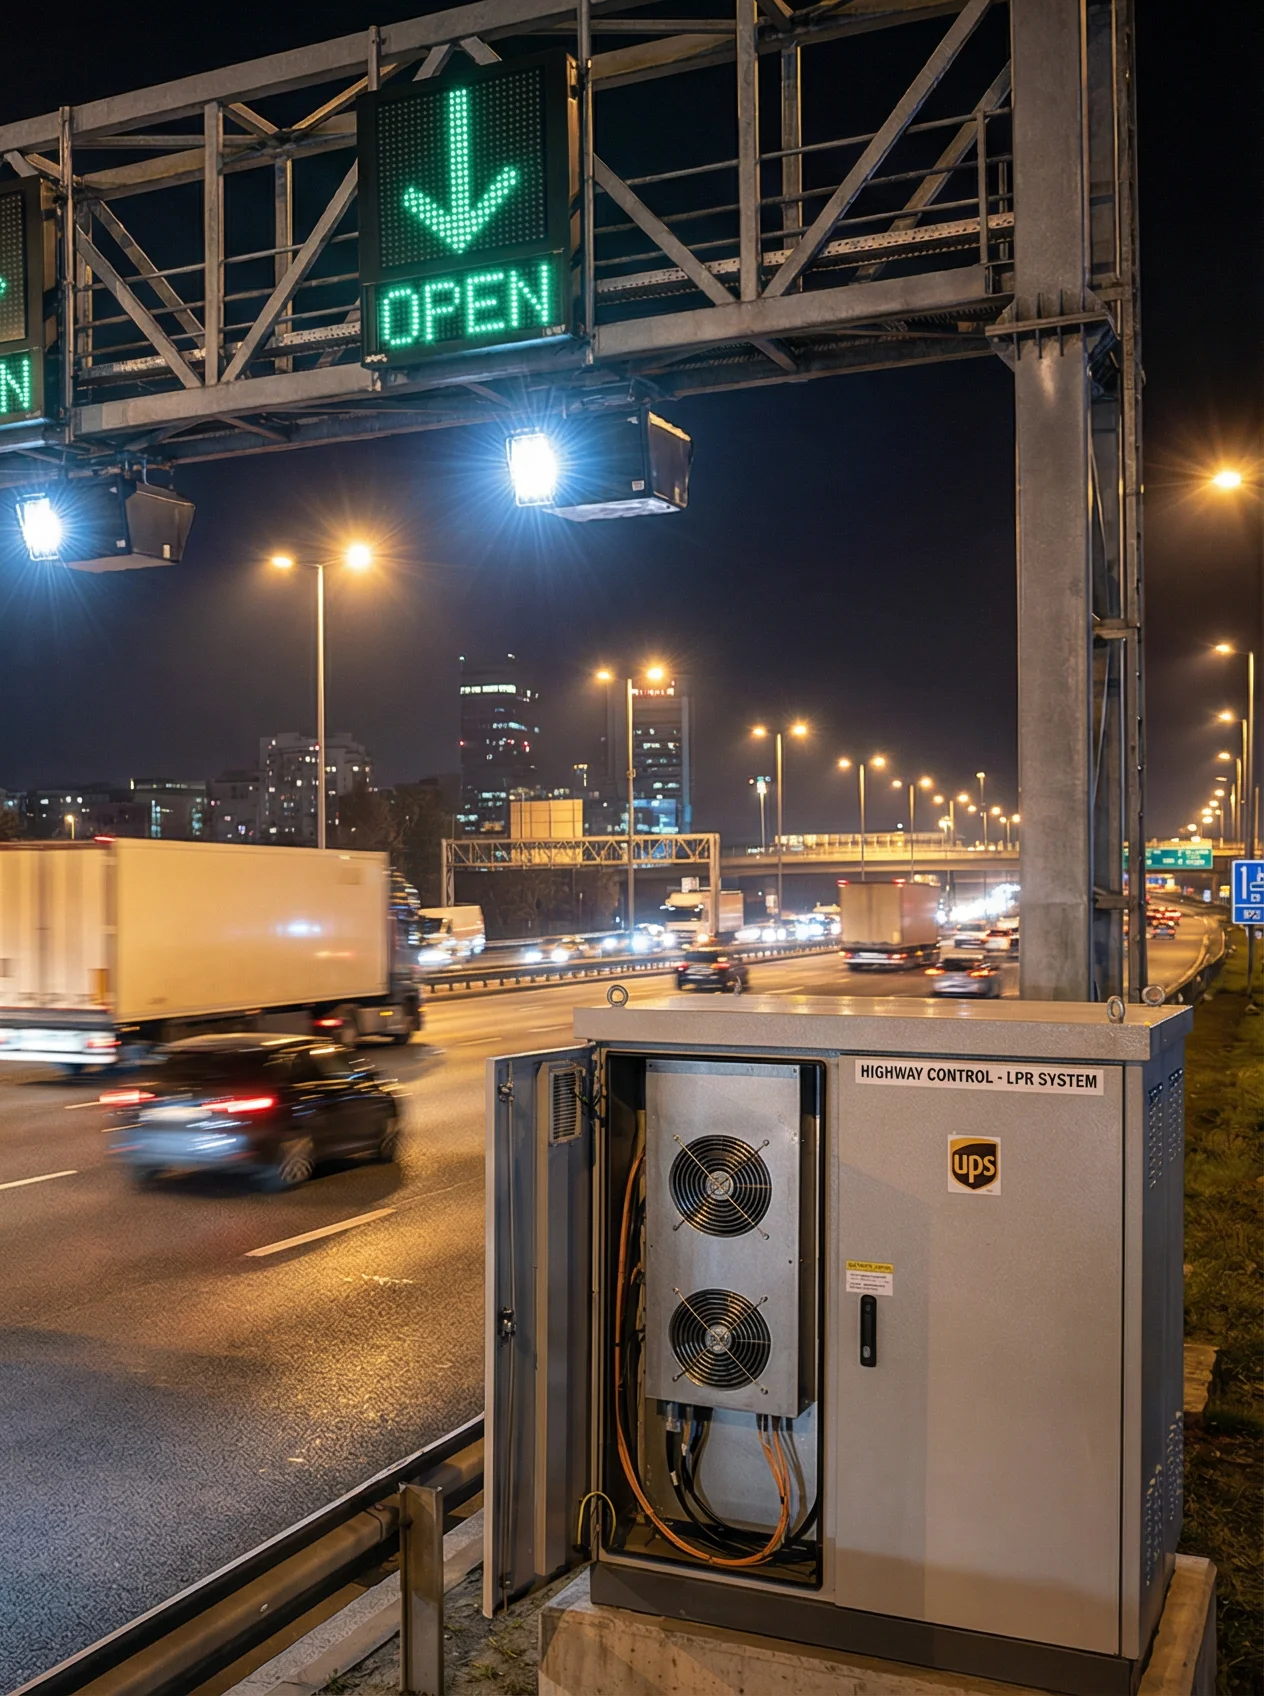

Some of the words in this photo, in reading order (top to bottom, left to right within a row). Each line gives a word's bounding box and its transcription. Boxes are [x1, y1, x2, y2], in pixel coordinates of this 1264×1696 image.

[382, 263, 550, 346] OPEN
[860, 1064, 924, 1081] HIGHWAY
[927, 1067, 994, 1084] CONTROL
[1006, 1070, 1034, 1086] LPR
[1038, 1072, 1098, 1089] SYSTEM
[953, 1154, 996, 1184] ups
